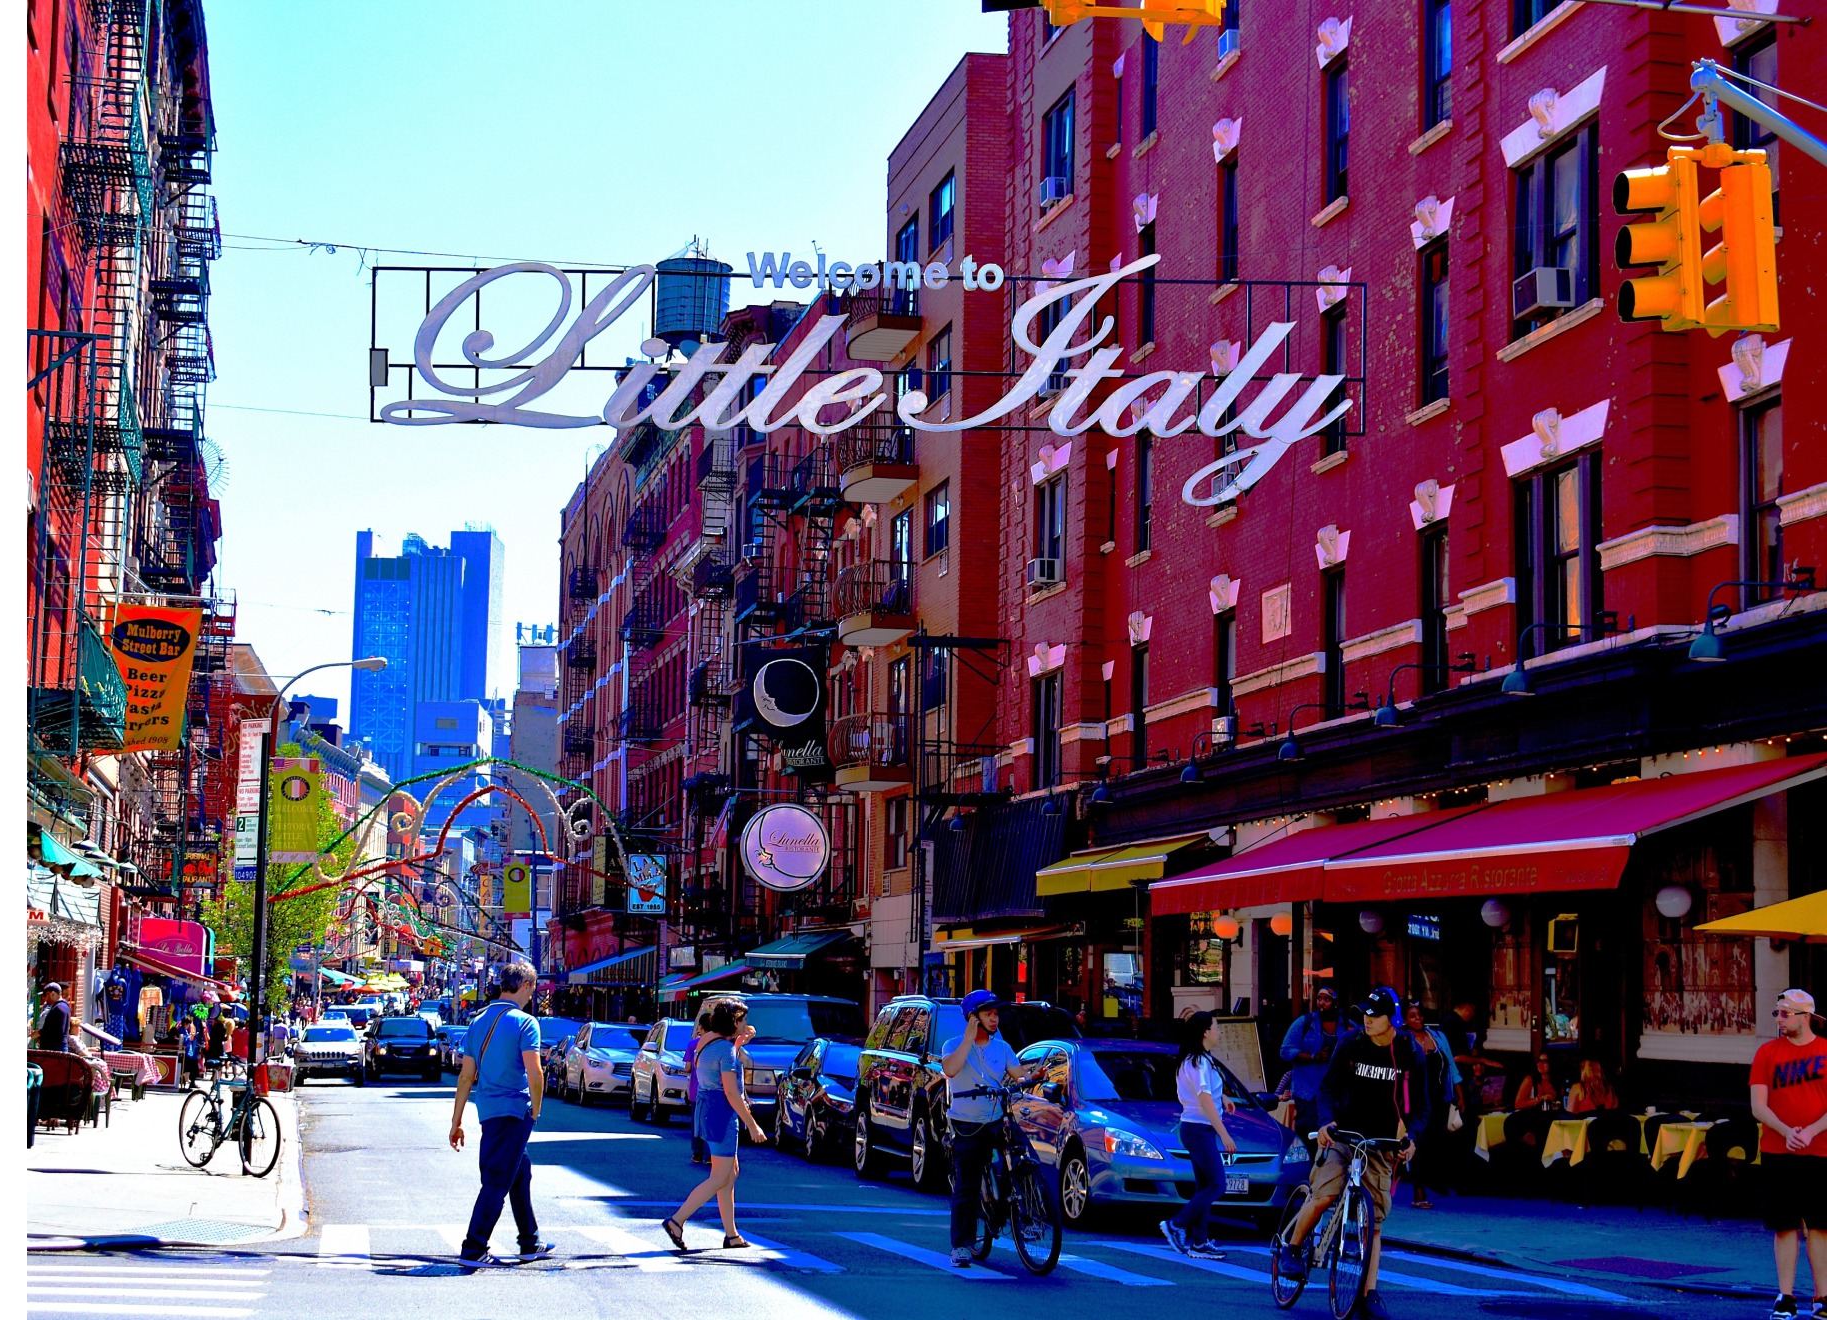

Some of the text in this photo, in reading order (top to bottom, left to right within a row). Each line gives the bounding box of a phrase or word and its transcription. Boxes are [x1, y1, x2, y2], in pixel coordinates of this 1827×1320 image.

[747, 250, 1004, 291] Welcome to
[379, 253, 1353, 507] Little Italy
[126, 623, 182, 643] Mulberry
[122, 638, 180, 656] Street Bar
[127, 668, 167, 683] Beer
[242, 721, 263, 730] NO PARKING
[148, 736, 169, 745] 1908
[274, 805, 315, 813] WELCOME
[238, 818, 244, 831] 2
[275, 822, 313, 831] HISTORIC
[274, 832, 303, 840] LITTLE
[766, 829, 821, 848] Lunella
[235, 870, 257, 880] 104902
[1383, 869, 1417, 894] Grotta
[1470, 862, 1538, 889] Ristorante
[1772, 1054, 1827, 1091] NIKE
